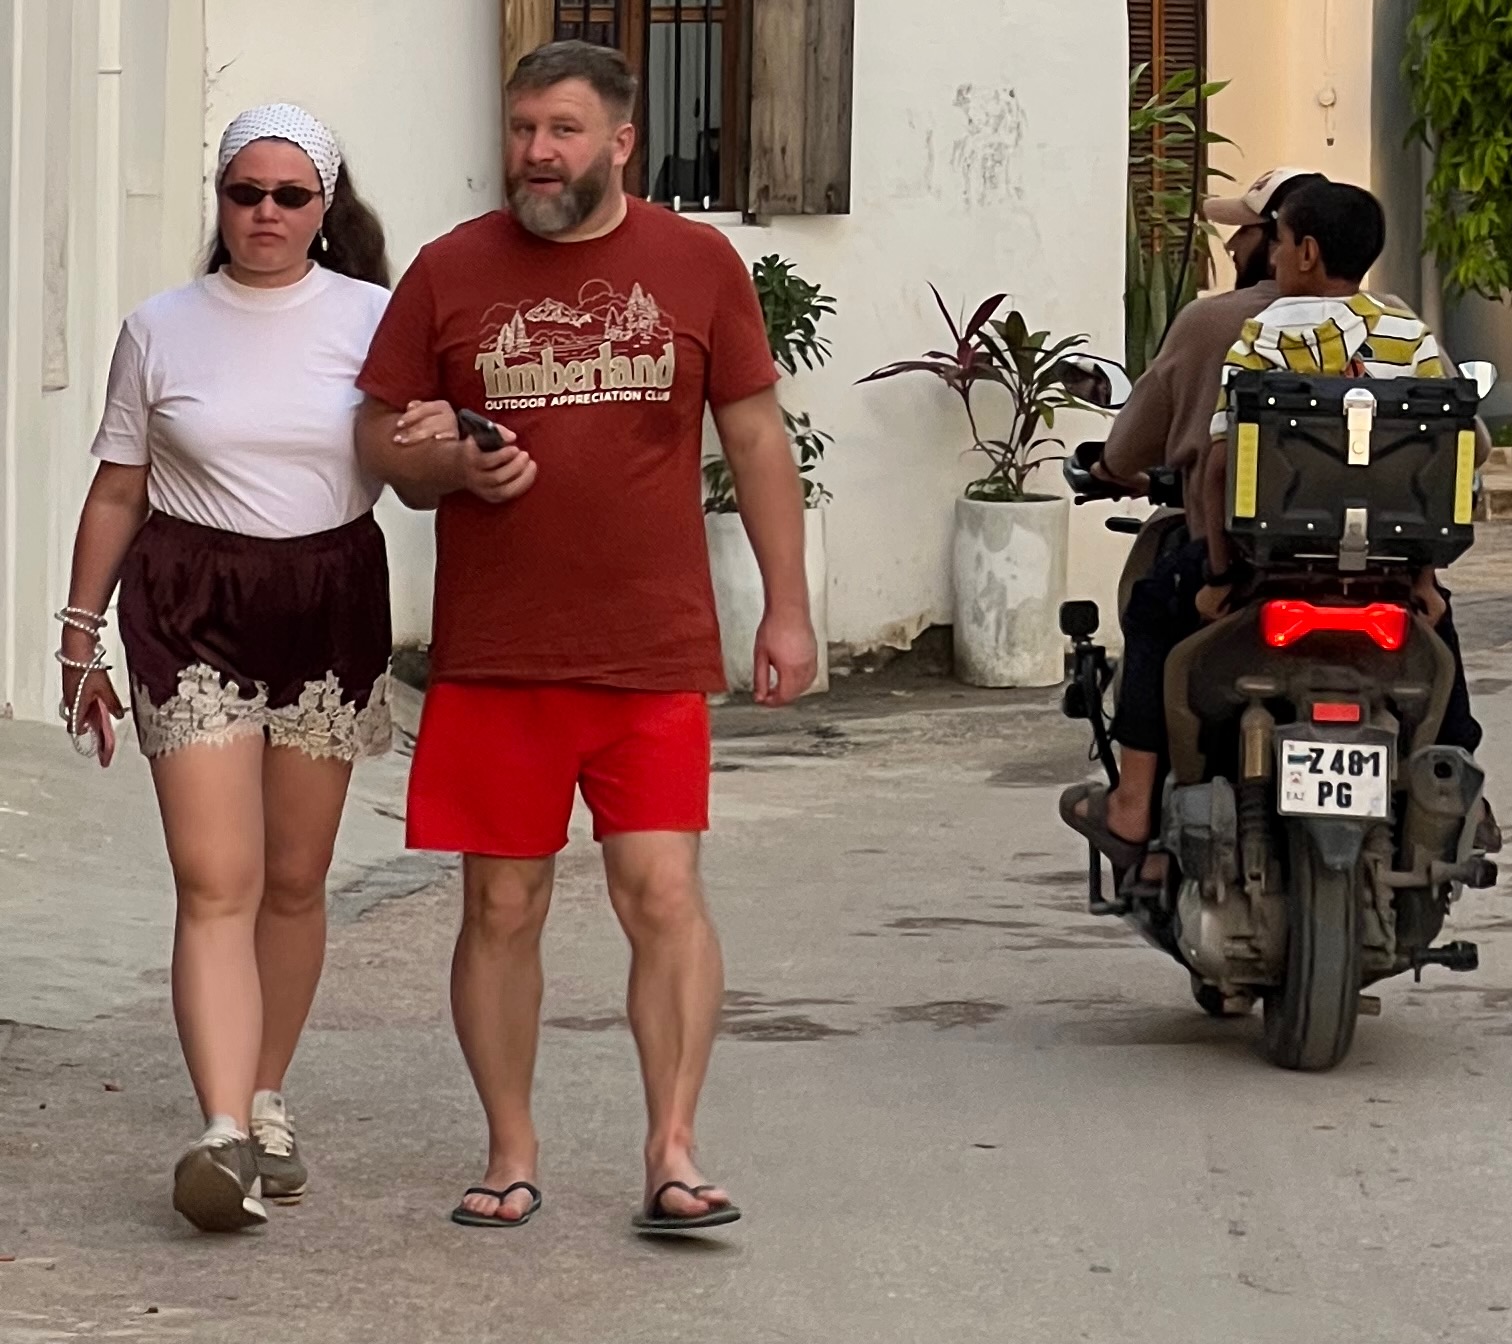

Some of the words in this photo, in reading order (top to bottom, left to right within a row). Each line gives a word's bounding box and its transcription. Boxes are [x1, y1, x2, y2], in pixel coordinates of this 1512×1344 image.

[475, 341, 675, 398] Timberland
[485, 397, 546, 411] OUTDOOR
[550, 390, 642, 407] APPRECIATION
[645, 390, 671, 402] CLUB
[1308, 747, 1325, 774] Z
[1329, 749, 1380, 778] 481
[1317, 781, 1352, 809] PG
